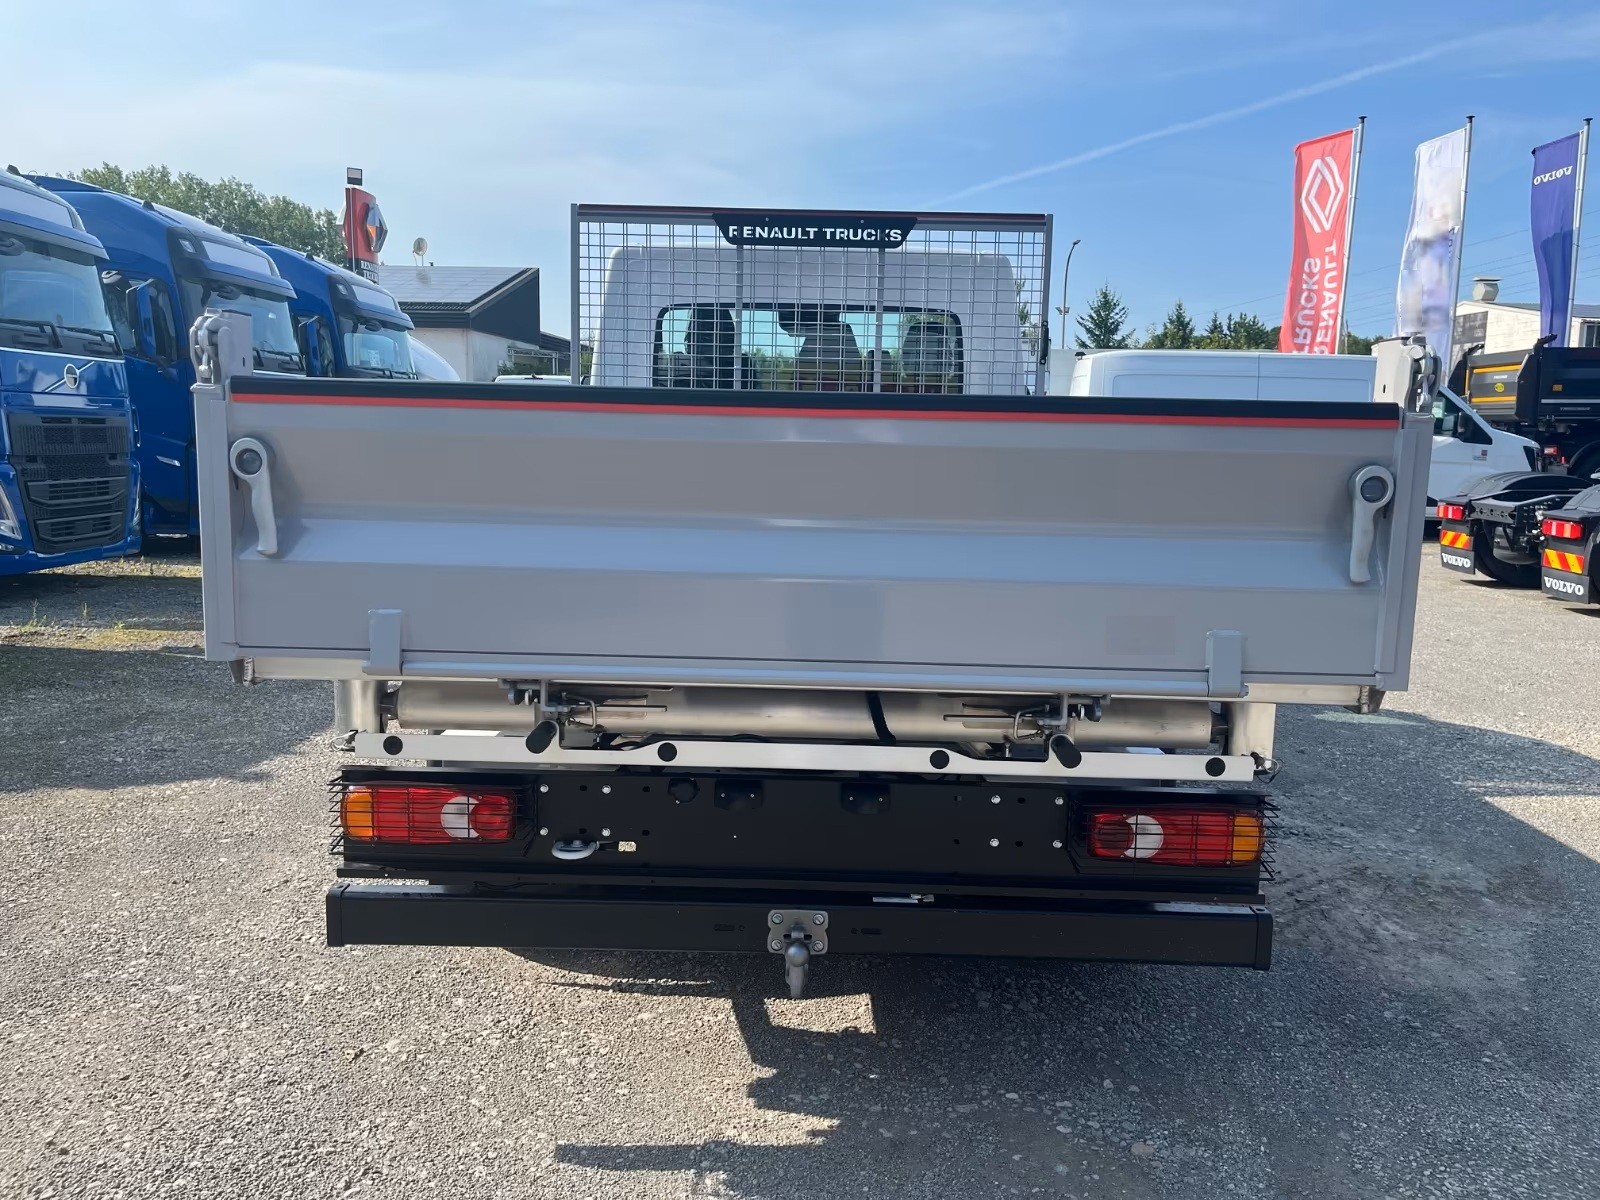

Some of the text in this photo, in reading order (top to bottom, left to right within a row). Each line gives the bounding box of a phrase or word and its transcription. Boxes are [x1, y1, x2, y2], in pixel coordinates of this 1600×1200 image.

[728, 225, 819, 240] RENAULT
[1441, 552, 1471, 568] VOLVO
[1543, 576, 1585, 596] VOLVO
